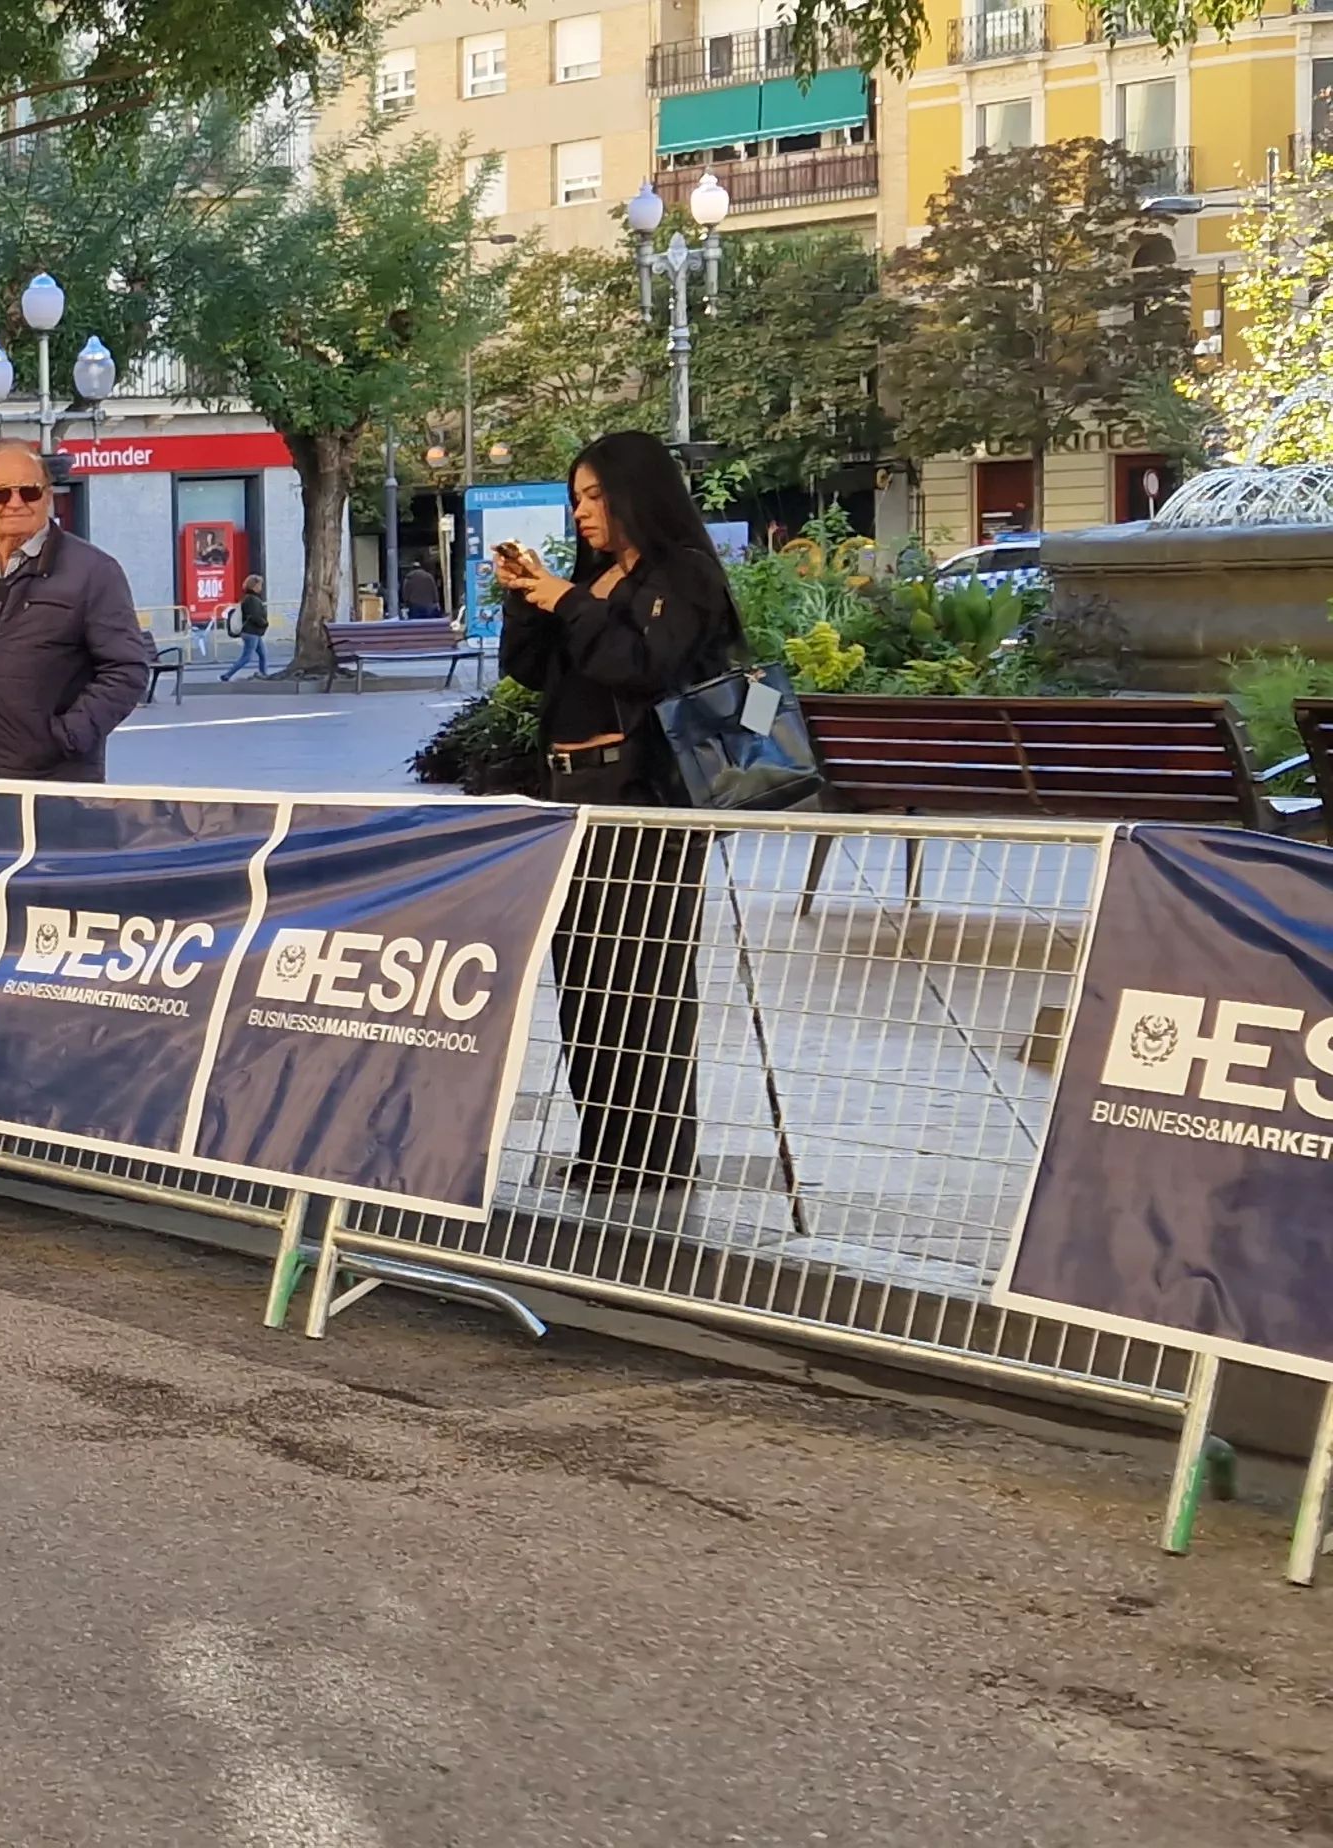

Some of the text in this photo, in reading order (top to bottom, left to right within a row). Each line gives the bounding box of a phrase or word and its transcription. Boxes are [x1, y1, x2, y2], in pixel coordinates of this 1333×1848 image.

[57, 445, 154, 469] antander
[473, 490, 525, 502] HUESCA
[60, 911, 215, 989] ESIC
[314, 929, 498, 1022] ESIC
[247, 1008, 480, 1054] BUSINESS&MARKETINGSCHOOL
